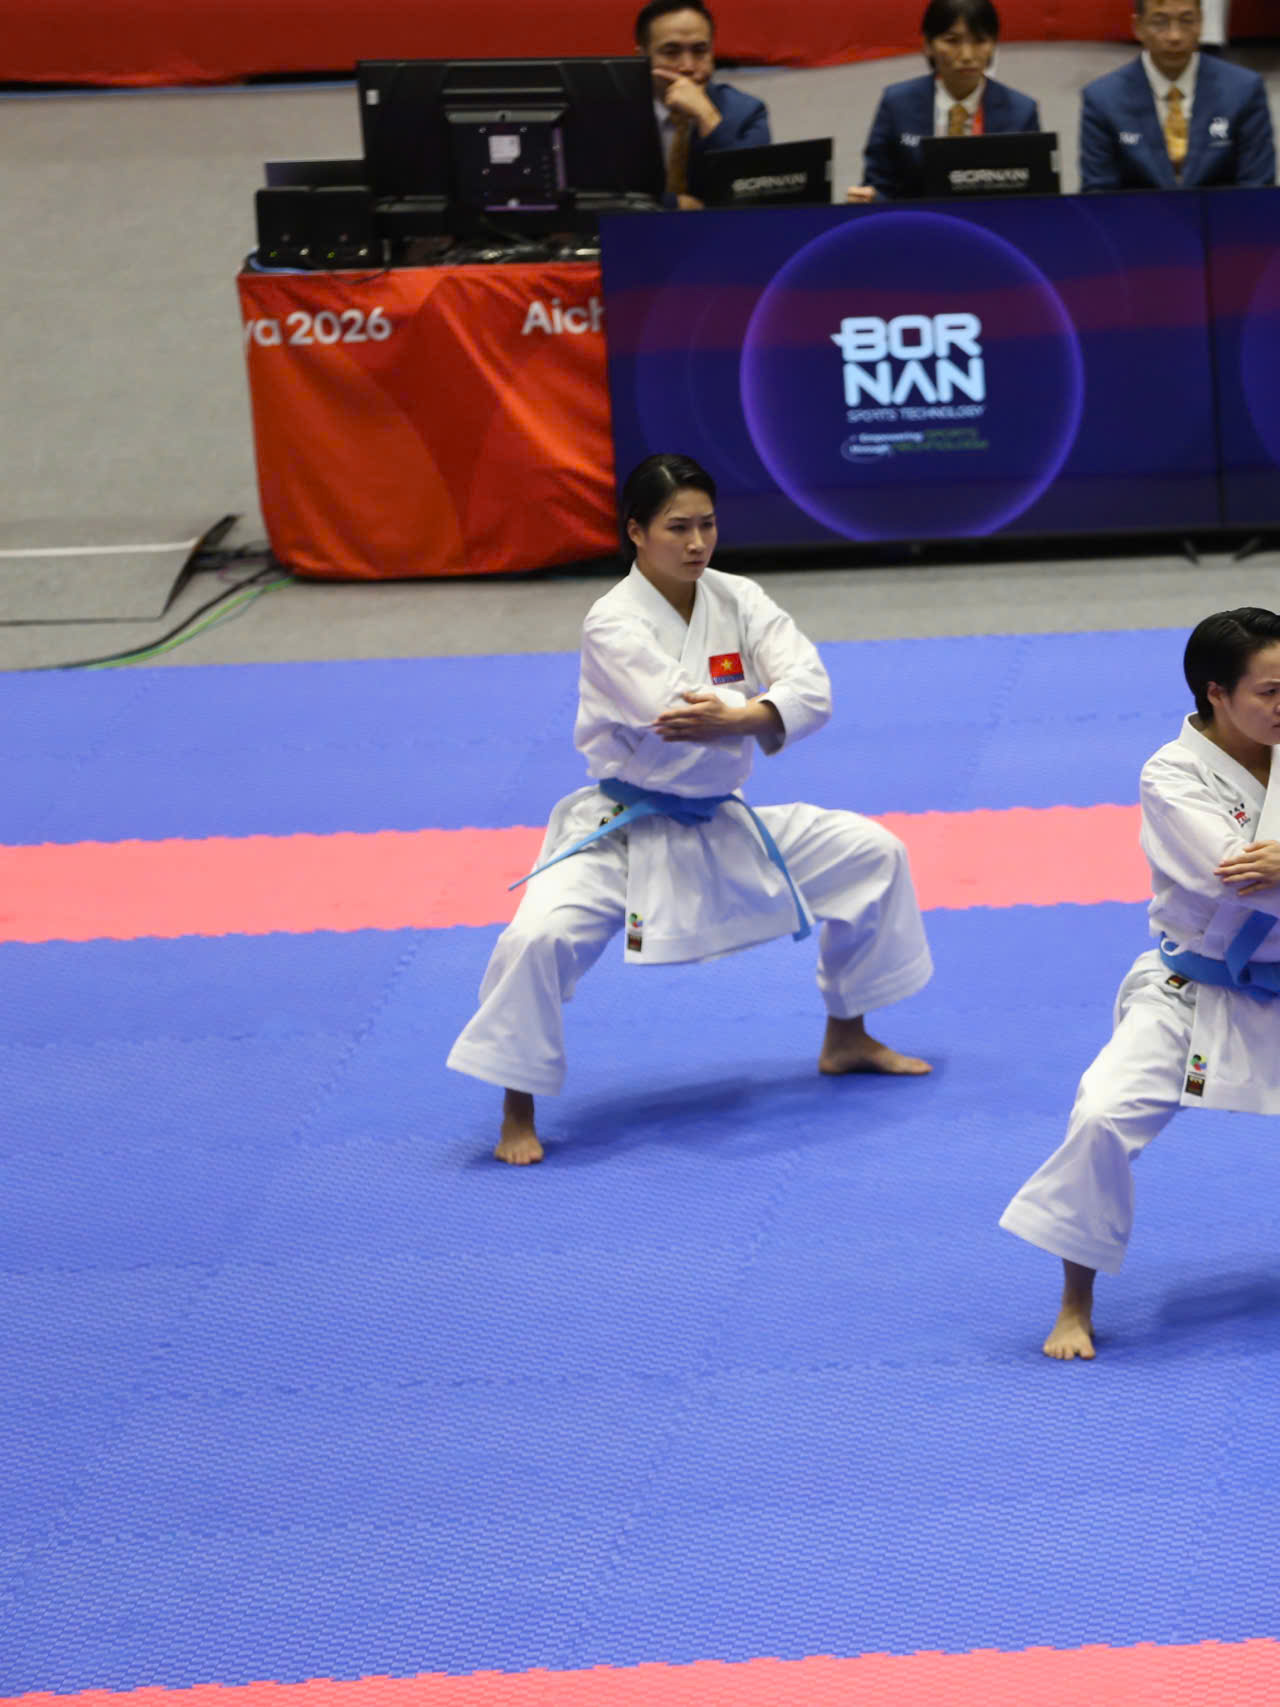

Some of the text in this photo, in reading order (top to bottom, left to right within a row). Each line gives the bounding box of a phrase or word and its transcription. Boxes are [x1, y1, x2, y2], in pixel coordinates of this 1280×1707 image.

[285, 306, 393, 345] 2026
[830, 313, 982, 362] BOR
[842, 357, 987, 407] NAN
